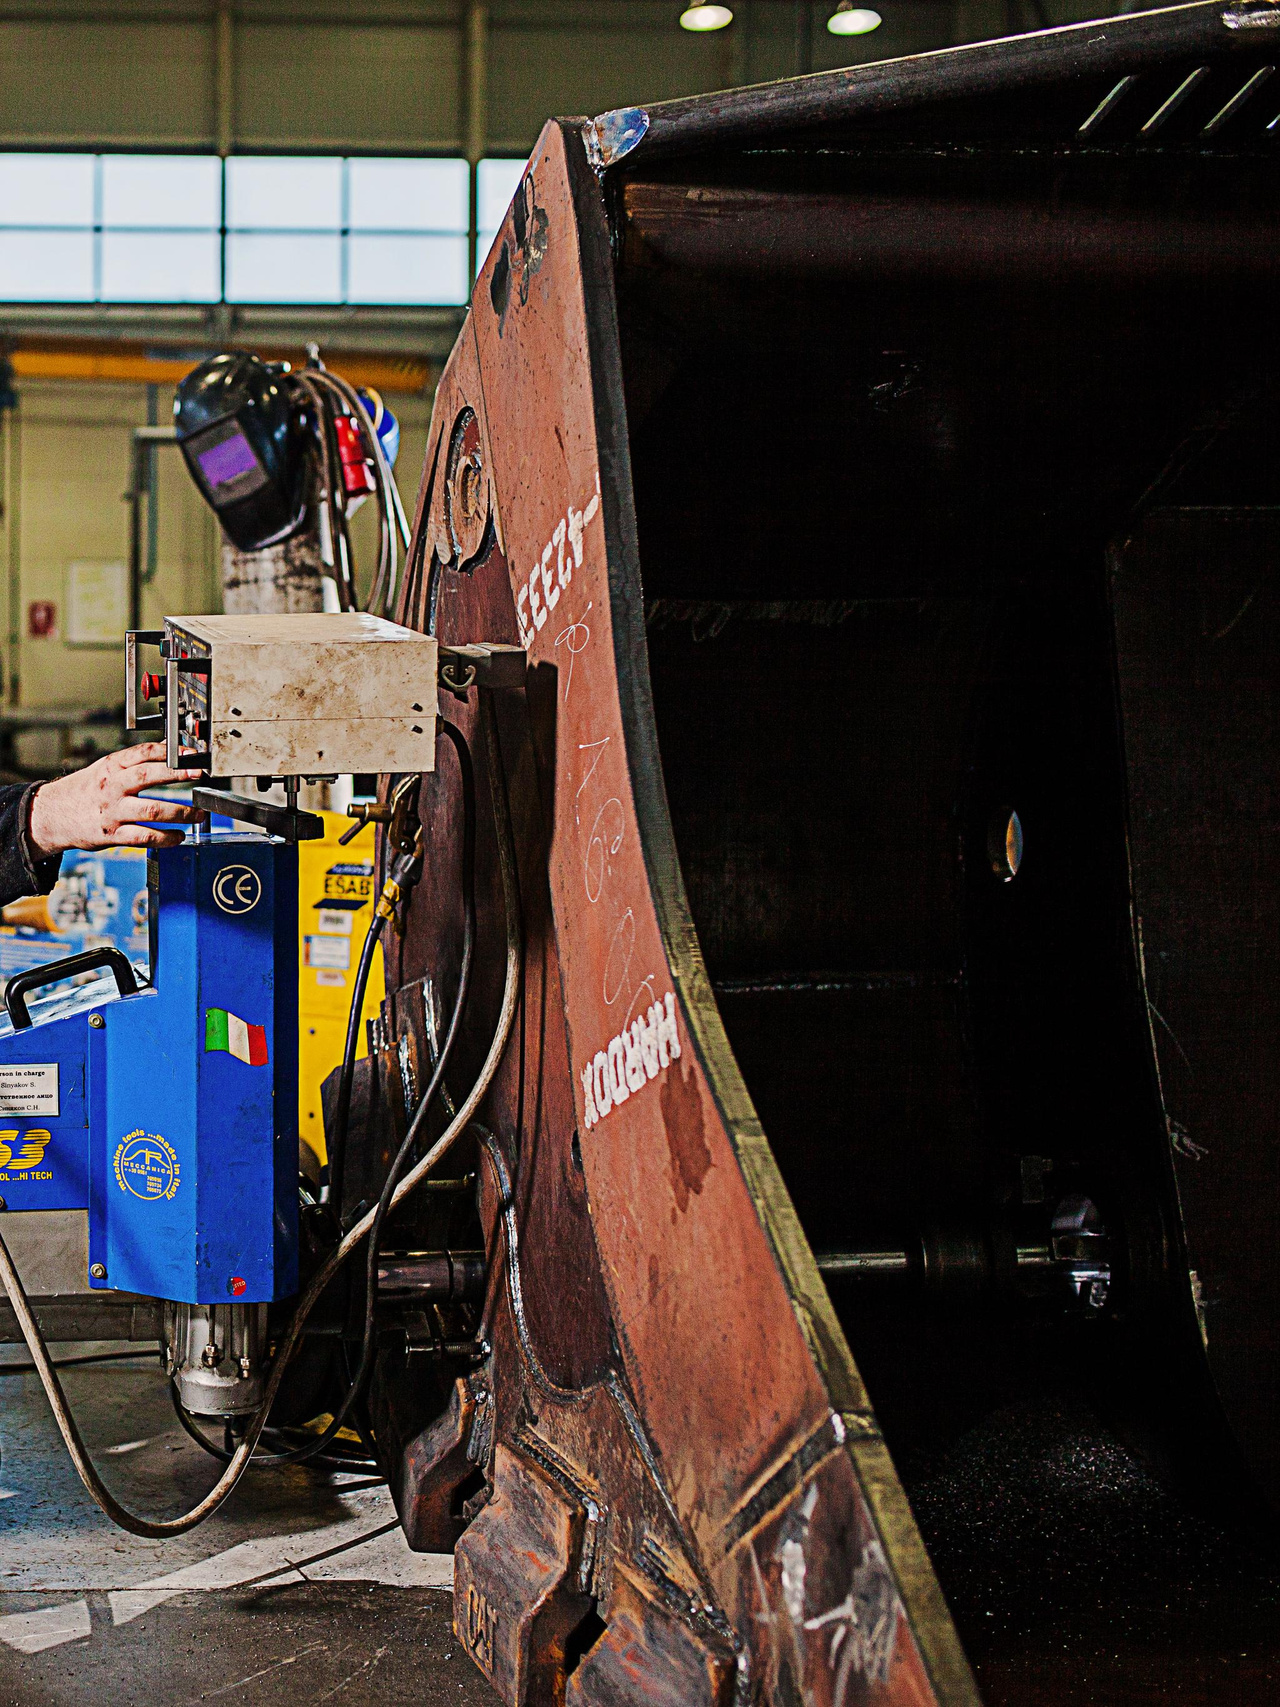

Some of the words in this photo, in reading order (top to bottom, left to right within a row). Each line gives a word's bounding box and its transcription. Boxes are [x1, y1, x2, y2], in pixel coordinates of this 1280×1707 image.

[217, 873, 252, 905] CE
[324, 876, 371, 896] ESAB
[581, 993, 681, 1128] HARDOX
[113, 1144, 126, 1191] machine
[122, 1128, 145, 1143] tools
[173, 1163, 181, 1175] in
[123, 1160, 171, 1175] MECCANICA
[30, 1171, 52, 1180] TECH
